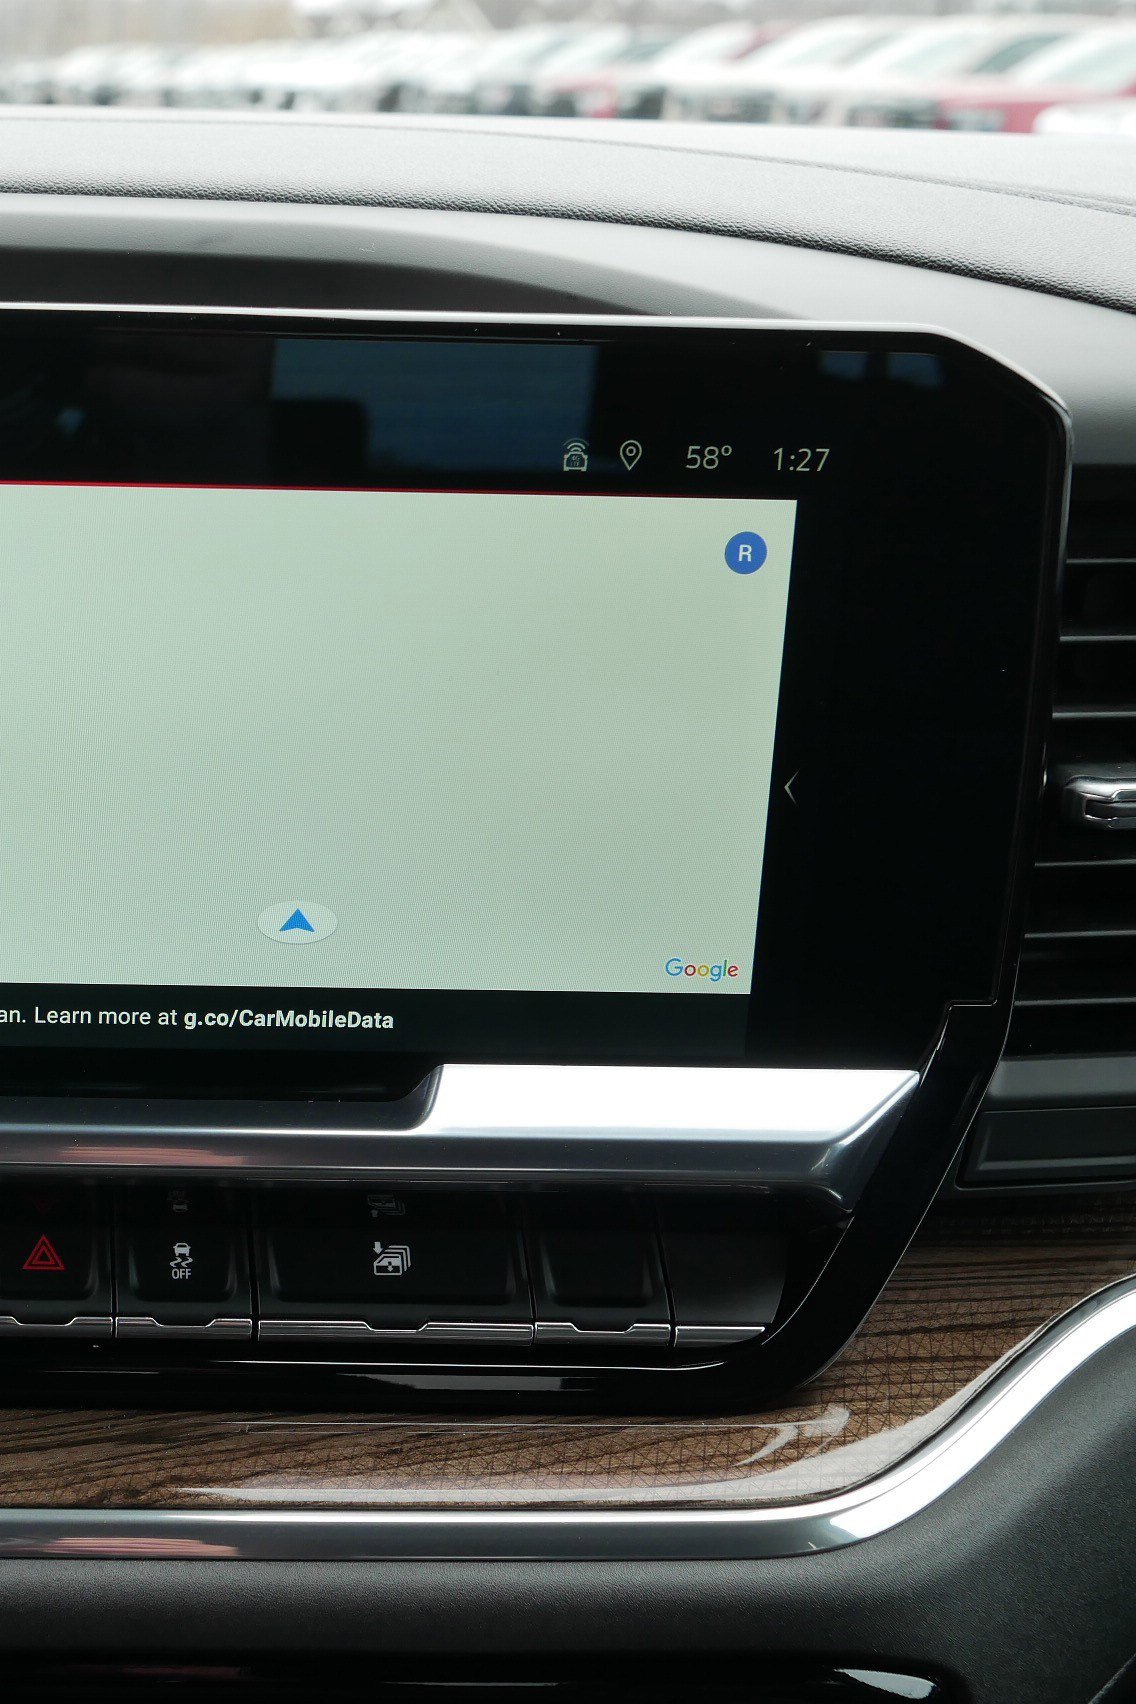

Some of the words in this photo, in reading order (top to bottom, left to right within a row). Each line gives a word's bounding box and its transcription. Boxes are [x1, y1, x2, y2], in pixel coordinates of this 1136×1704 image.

[773, 447, 831, 472] 1:27
[738, 544, 753, 562] R
[664, 957, 740, 982] Google
[34, 1006, 92, 1024] Learn
[98, 1011, 152, 1026] more
[157, 1009, 178, 1026] at
[183, 1009, 394, 1031] g.co/CarMobileData
[171, 1268, 192, 1280] OFF
